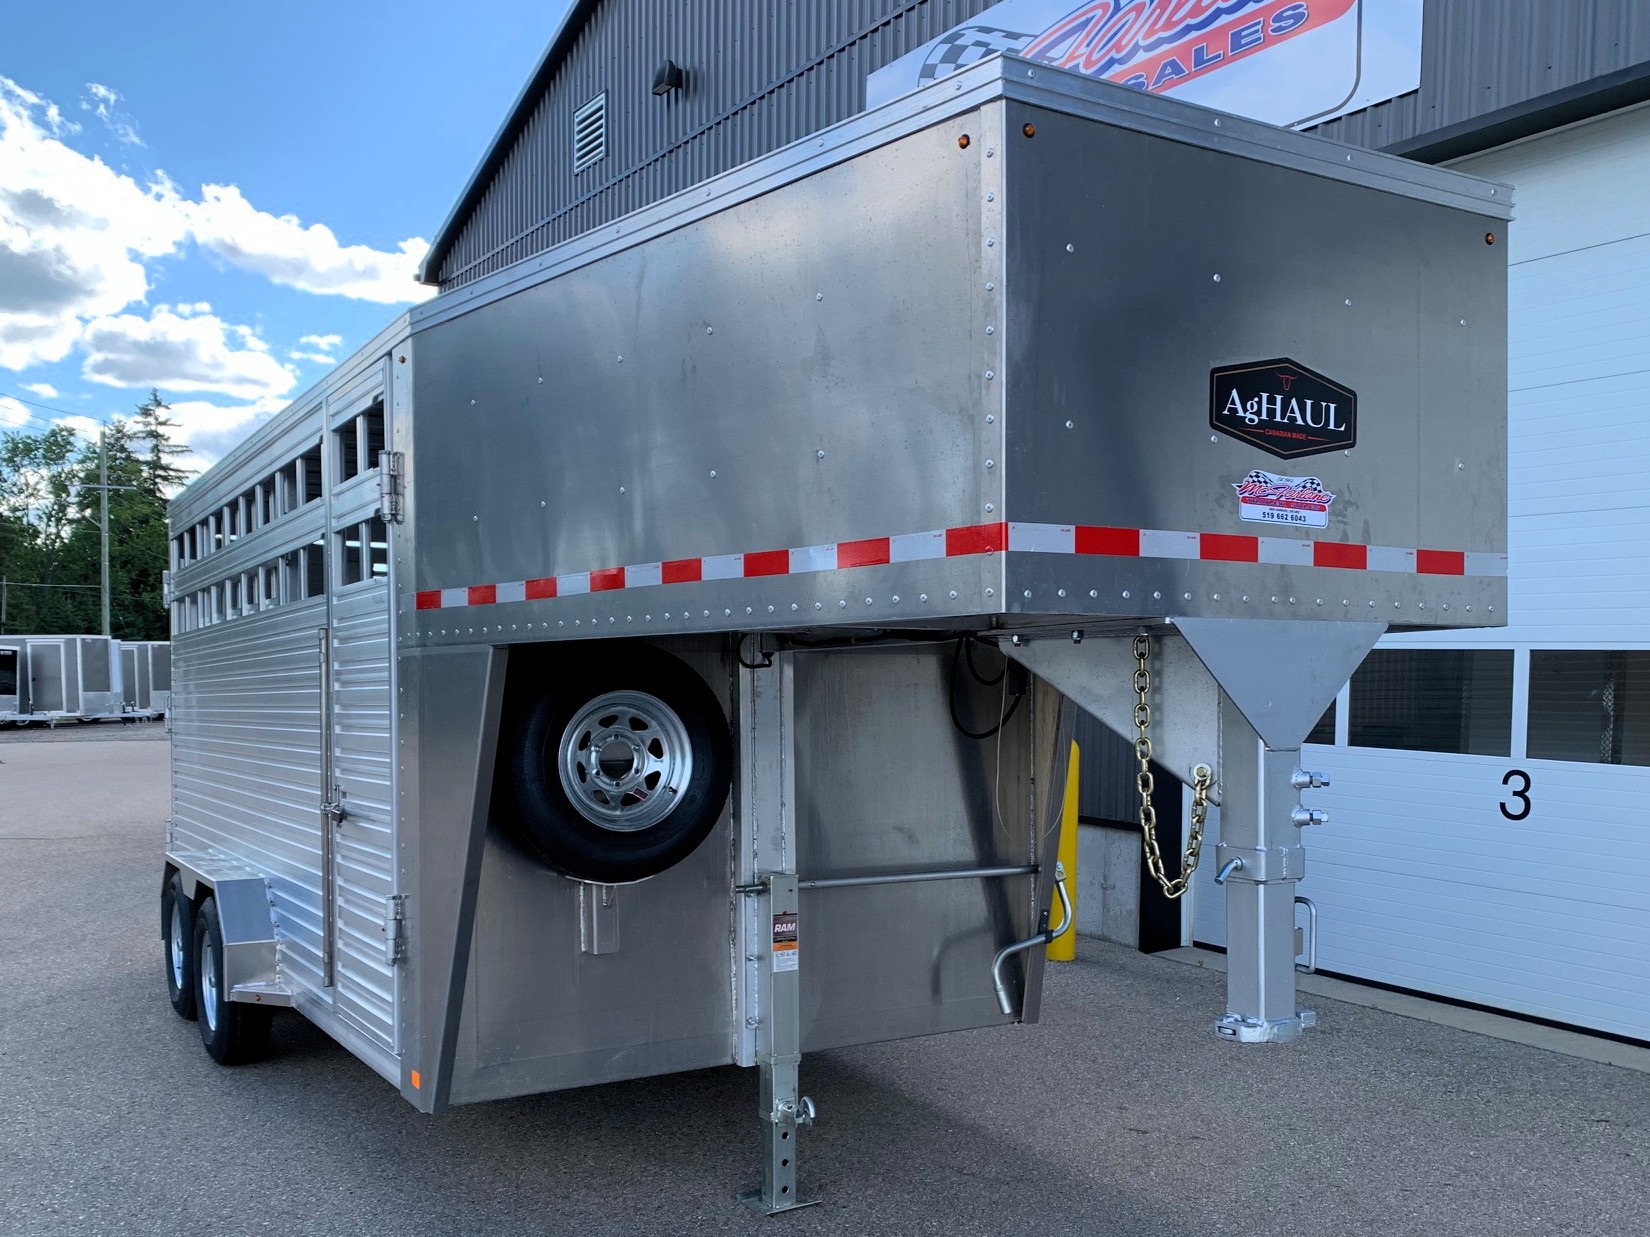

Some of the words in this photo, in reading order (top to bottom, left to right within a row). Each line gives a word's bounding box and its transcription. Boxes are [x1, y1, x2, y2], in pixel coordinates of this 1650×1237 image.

[1222, 388, 1346, 431] AgHAUL
[1262, 511, 1275, 519] 519
[1290, 514, 1307, 523] 6043
[1499, 769, 1531, 821] 3
[774, 923, 796, 932] RAM
